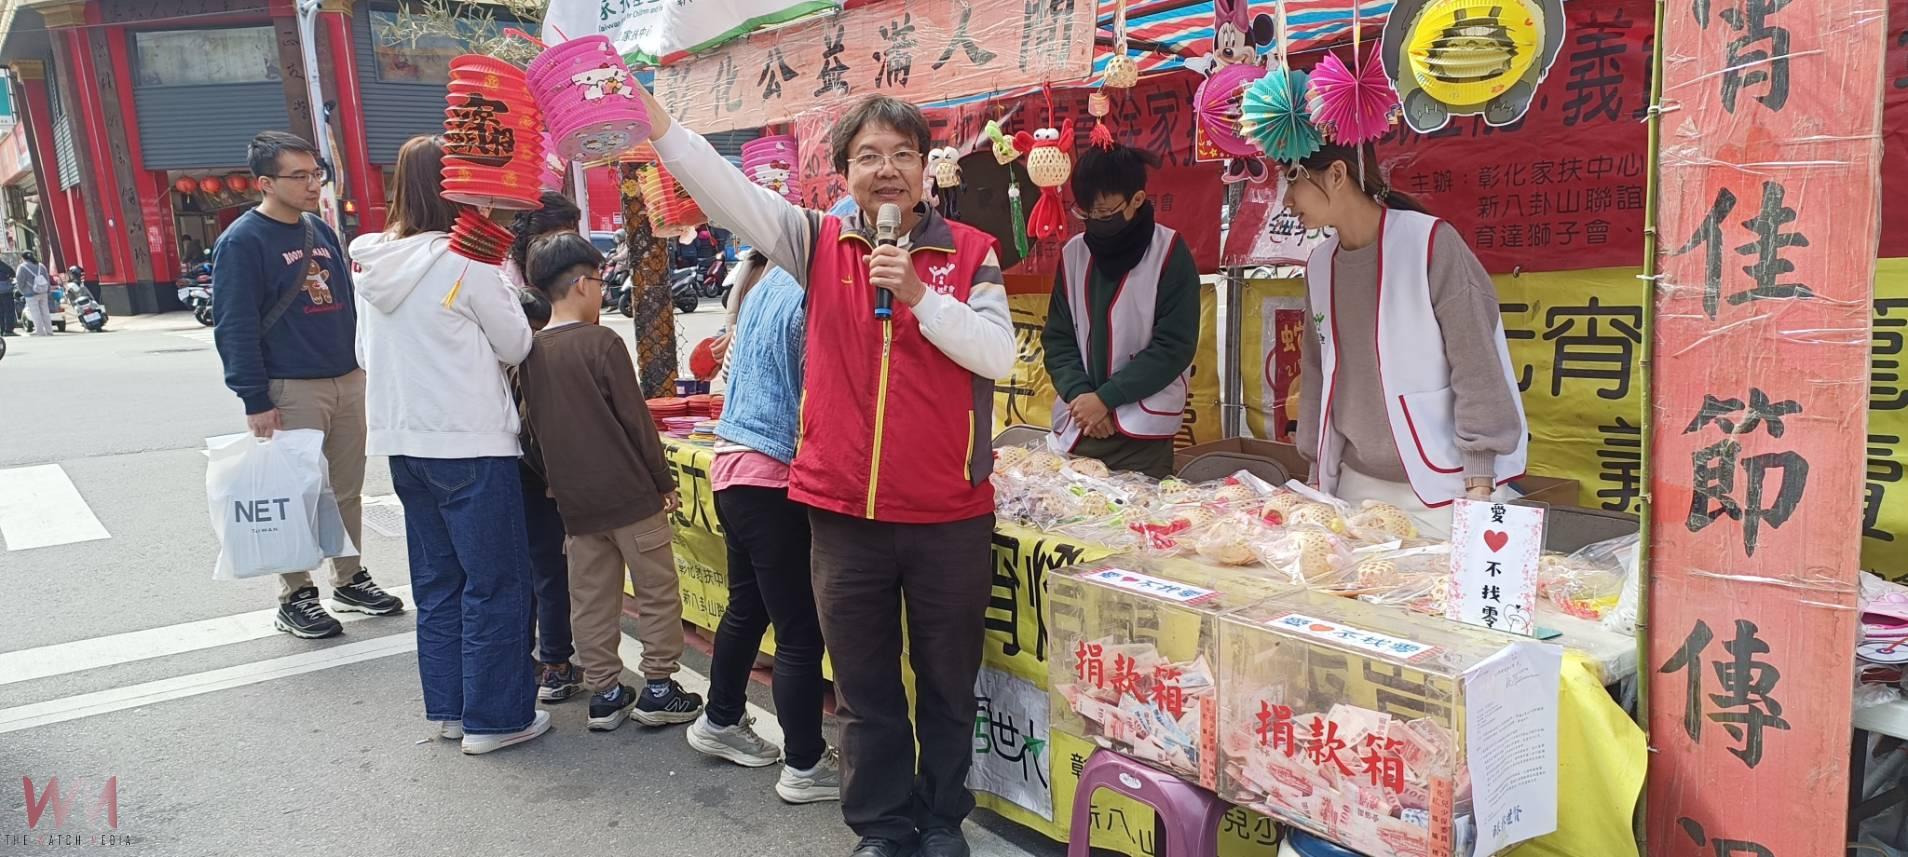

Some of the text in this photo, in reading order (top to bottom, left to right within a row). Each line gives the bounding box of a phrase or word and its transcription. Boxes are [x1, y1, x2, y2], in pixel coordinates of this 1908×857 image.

[1477, 185, 1643, 219] 新八卦山聯誼
[1478, 153, 1644, 190] 彰化家扶中心
[1657, 0, 1815, 857] 宵佳節傳
[235, 498, 290, 523] NET
[1482, 503, 1506, 629] 愛不找零
[1075, 640, 1184, 721] 捐款箱
[1255, 700, 1405, 795] 捐款箱
